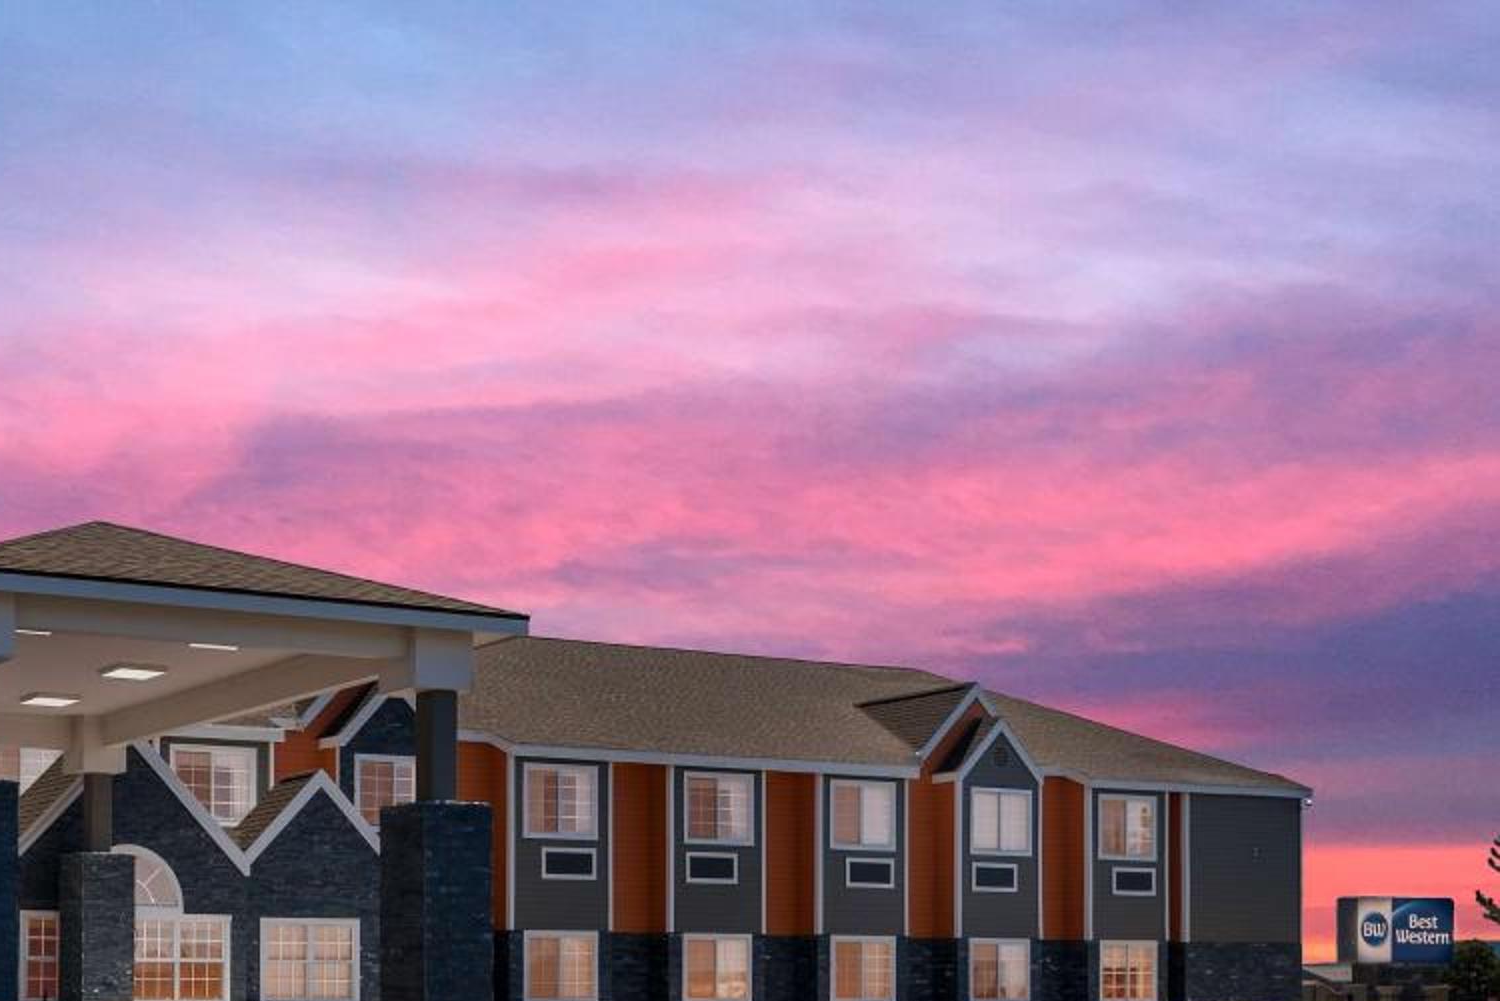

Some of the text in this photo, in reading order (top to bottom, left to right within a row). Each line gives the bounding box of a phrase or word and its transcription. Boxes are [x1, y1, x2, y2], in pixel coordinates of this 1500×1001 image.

[1363, 921, 1387, 937] BW
[1409, 913, 1438, 929] Best
[1395, 929, 1450, 944] Western
